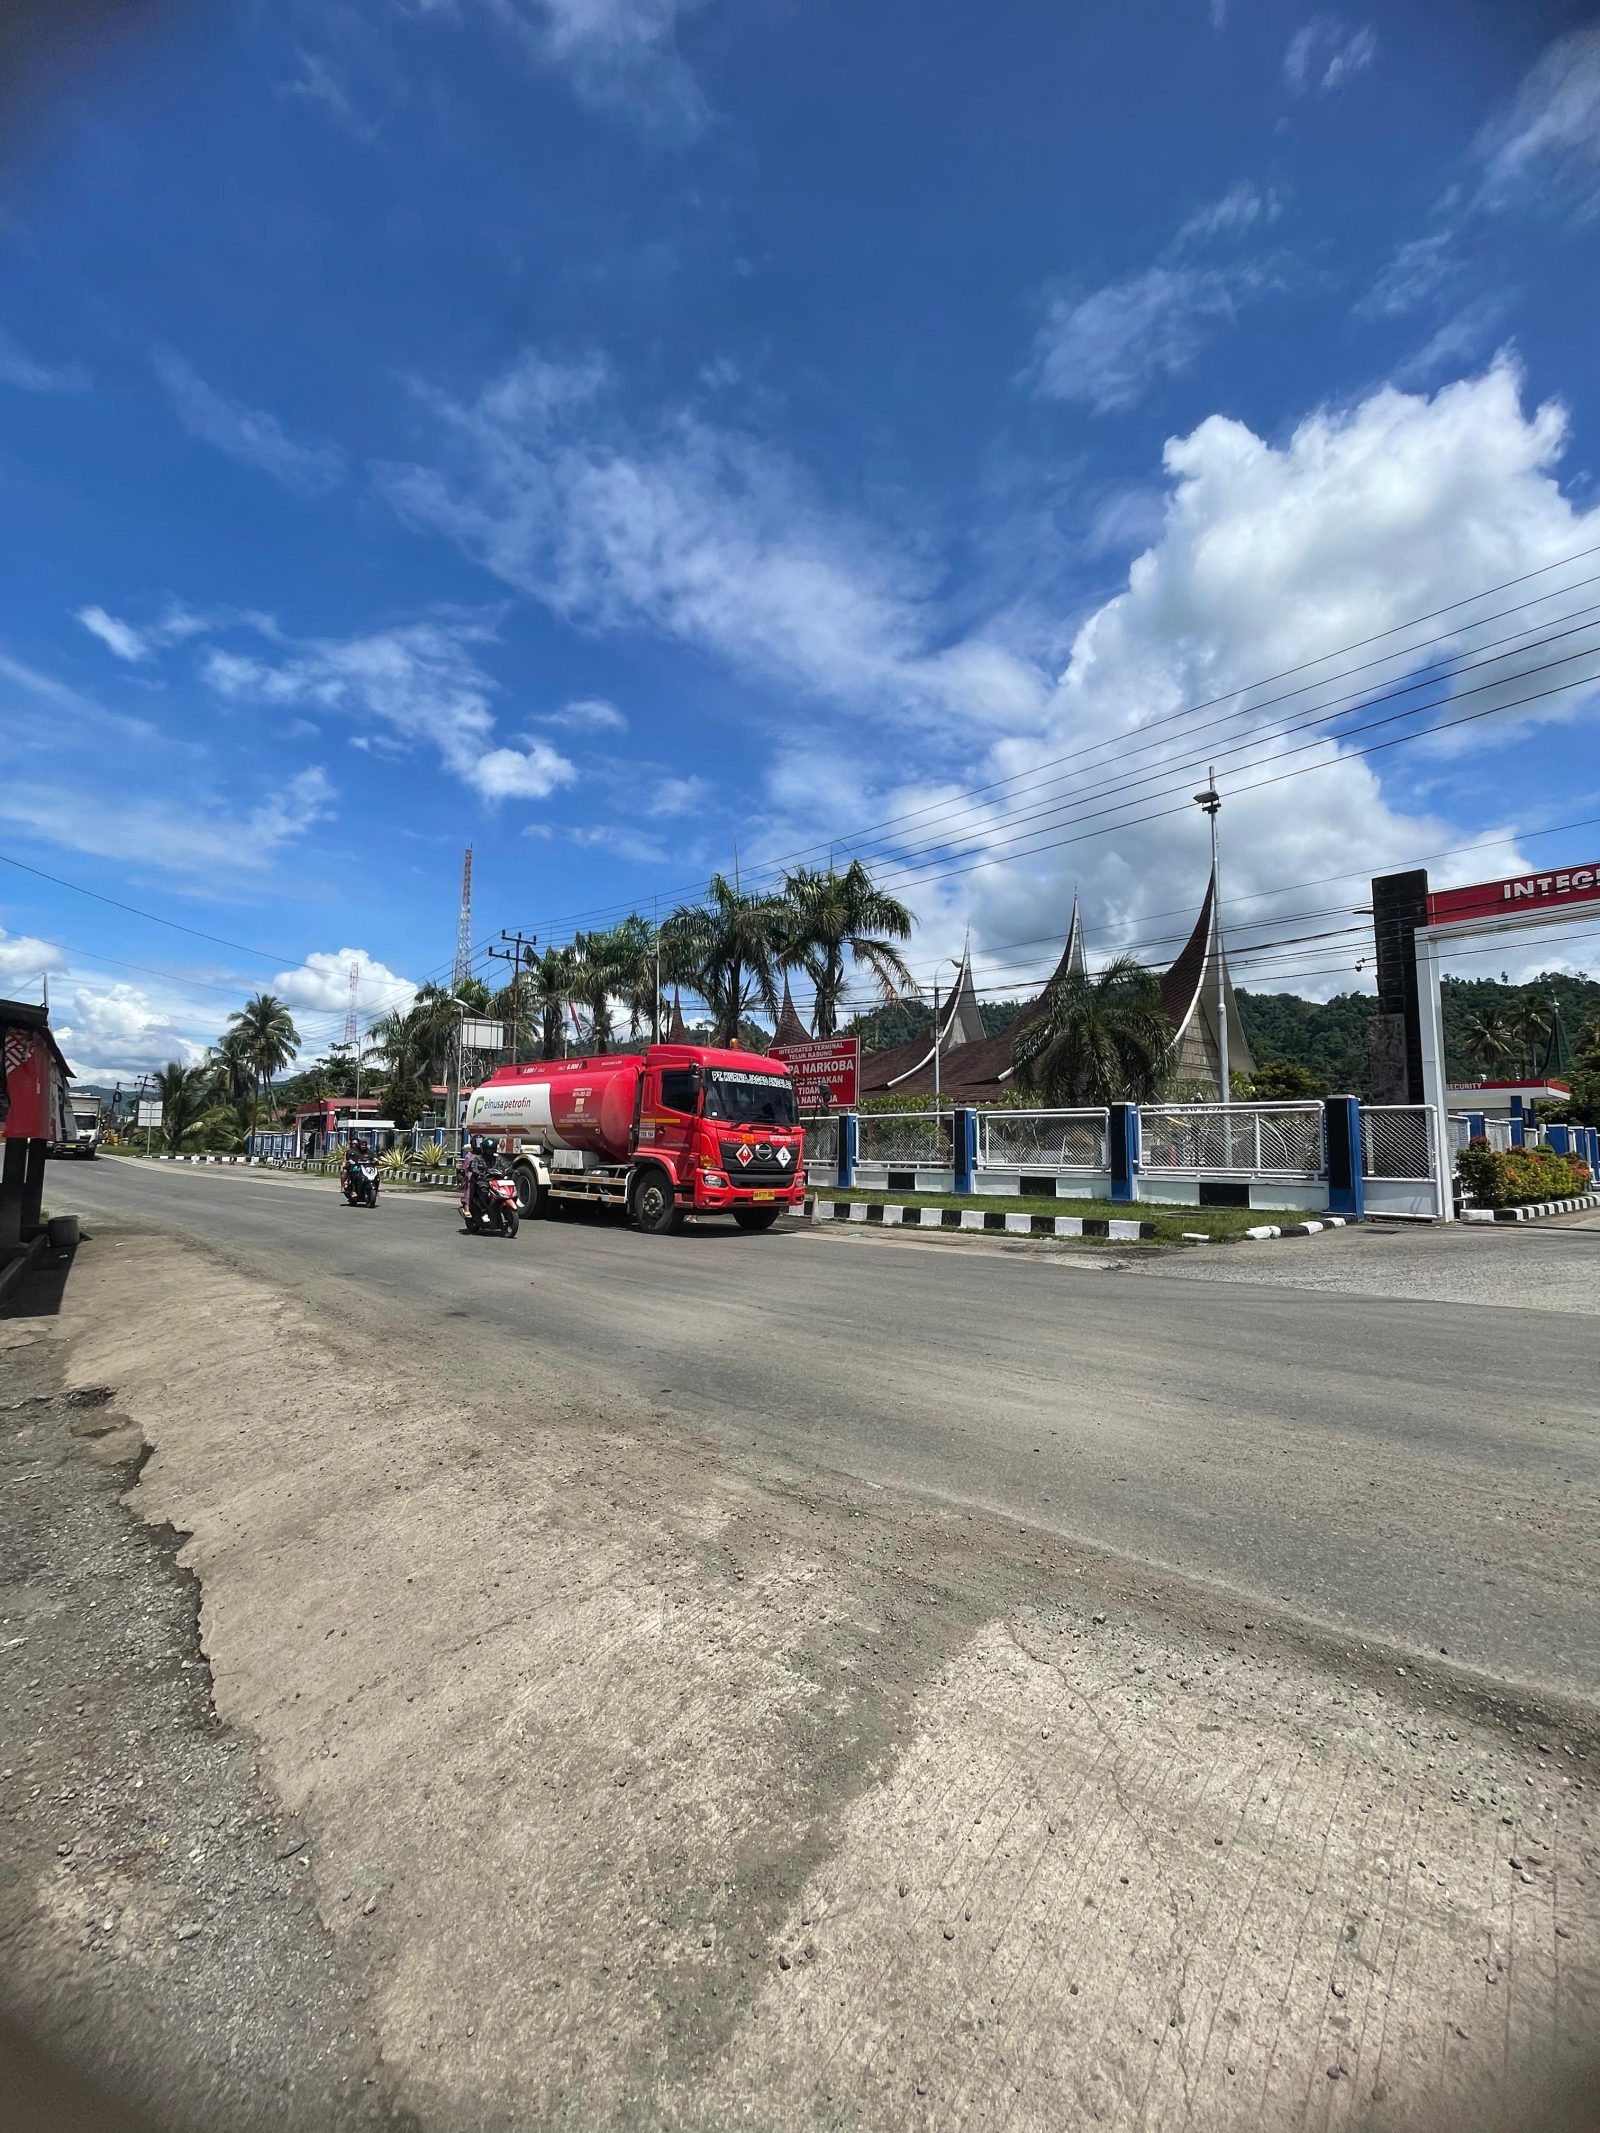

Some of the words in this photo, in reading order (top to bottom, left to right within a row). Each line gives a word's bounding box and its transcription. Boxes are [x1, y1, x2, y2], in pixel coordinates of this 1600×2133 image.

[1503, 868, 1600, 900] INTEG
[778, 1045, 813, 1055] INTEGRATED
[814, 1042, 844, 1051] TERMINAL
[789, 1052, 807, 1061] TELUK
[807, 1050, 833, 1059] KABUNG
[802, 1059, 854, 1075] NARKOBA
[806, 1074, 844, 1086] KATAKAN
[1446, 1082, 1482, 1090] SECURITY
[797, 1086, 820, 1096] TIDAK
